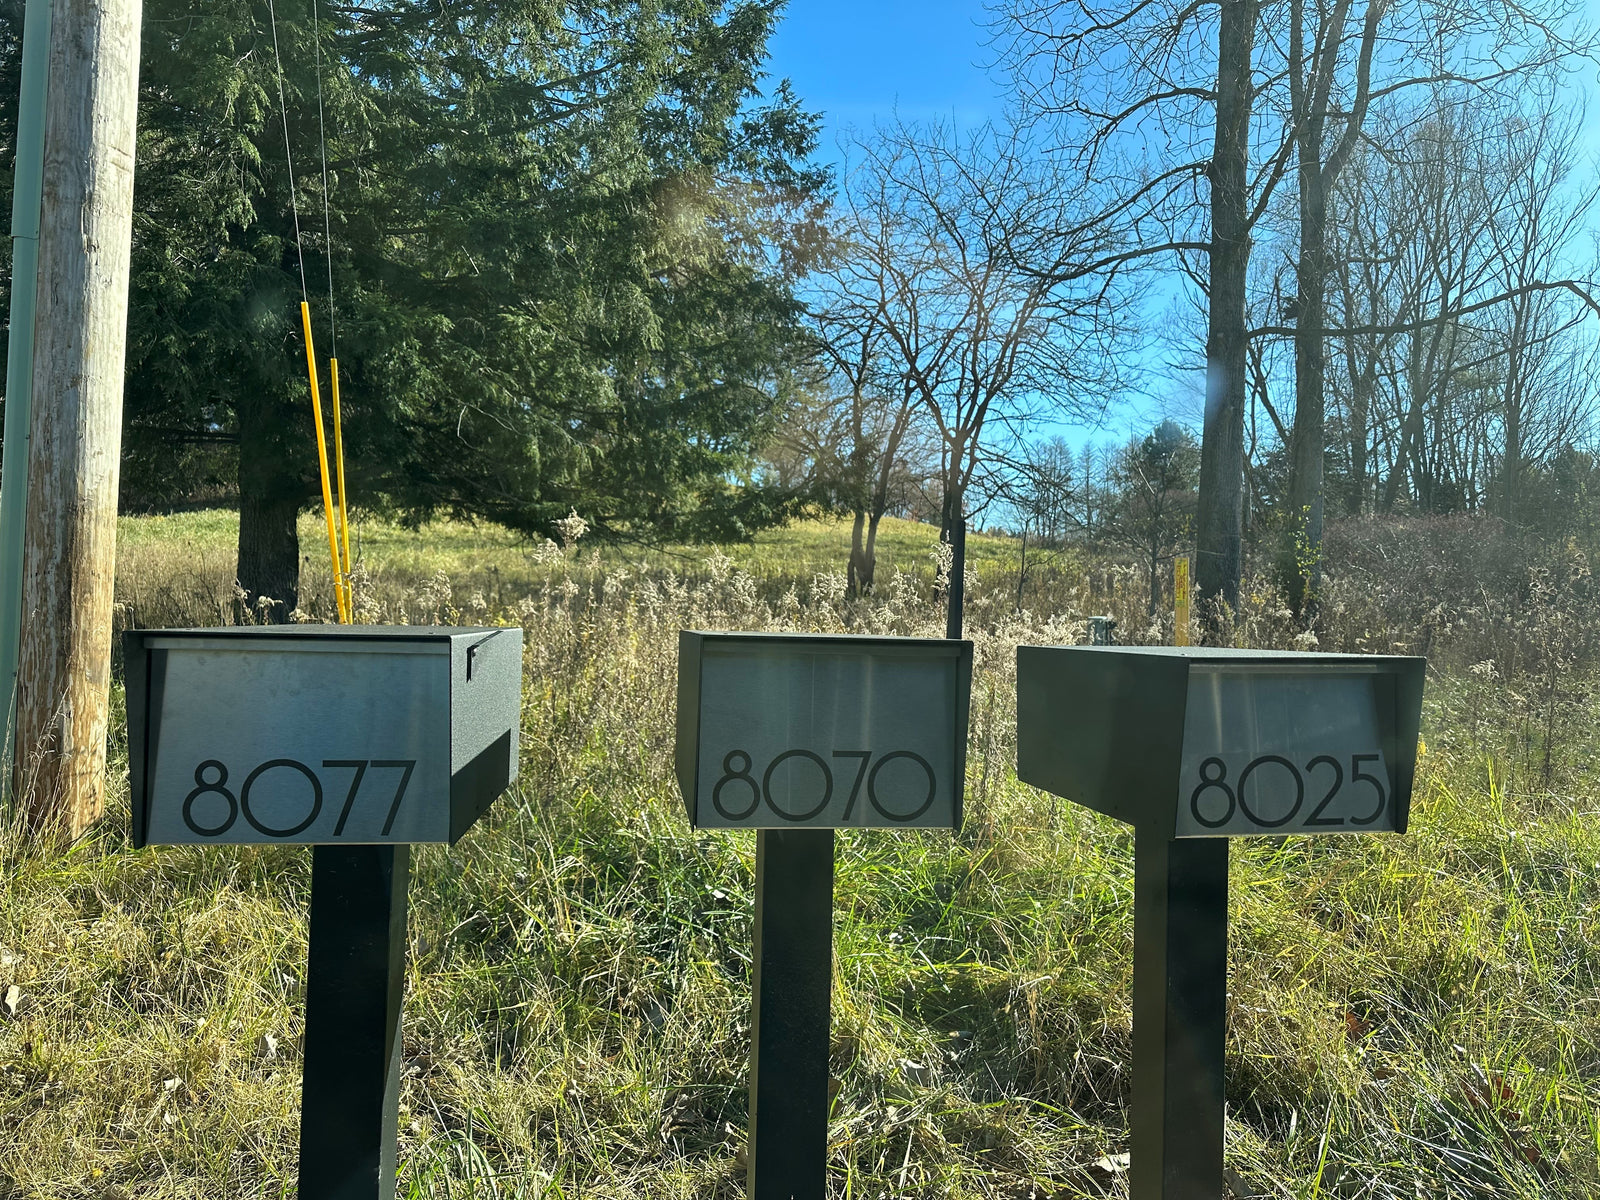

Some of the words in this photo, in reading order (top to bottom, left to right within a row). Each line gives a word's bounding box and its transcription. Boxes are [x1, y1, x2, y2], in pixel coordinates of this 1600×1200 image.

[182, 758, 417, 838] 8077
[712, 749, 937, 822] 8070
[1190, 754, 1386, 829] 8025
